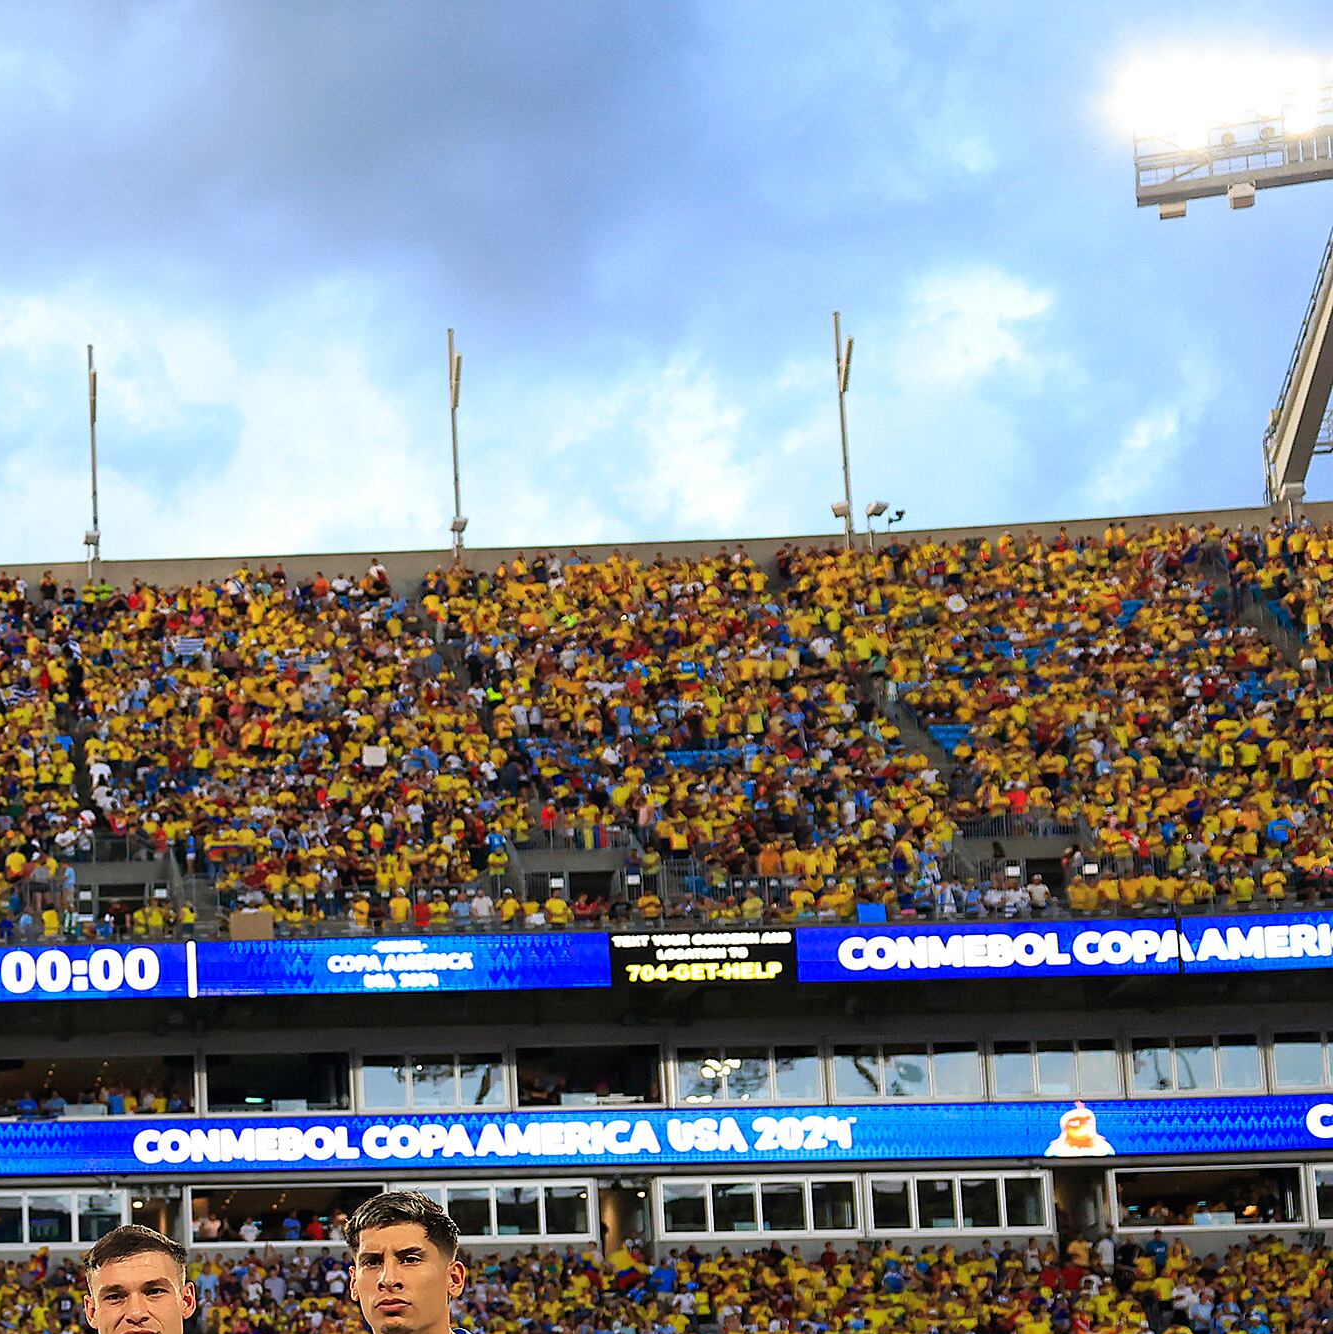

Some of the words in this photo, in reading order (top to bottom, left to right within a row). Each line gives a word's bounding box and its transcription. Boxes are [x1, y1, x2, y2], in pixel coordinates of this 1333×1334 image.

[0, 947, 160, 994] 00:00
[327, 954, 382, 973] COPA
[383, 952, 474, 972] AMERICA
[837, 931, 1072, 971] CONMEBOL
[1072, 929, 1196, 966] COPA
[1196, 923, 1333, 962] AMERI
[626, 961, 783, 982] 704-GET-HELP
[133, 1125, 361, 1163] CONMEBOL
[361, 1123, 476, 1160] COPA
[475, 1120, 662, 1157] AMERICA
[666, 1116, 750, 1152] USA
[751, 1115, 854, 1151] 2024
